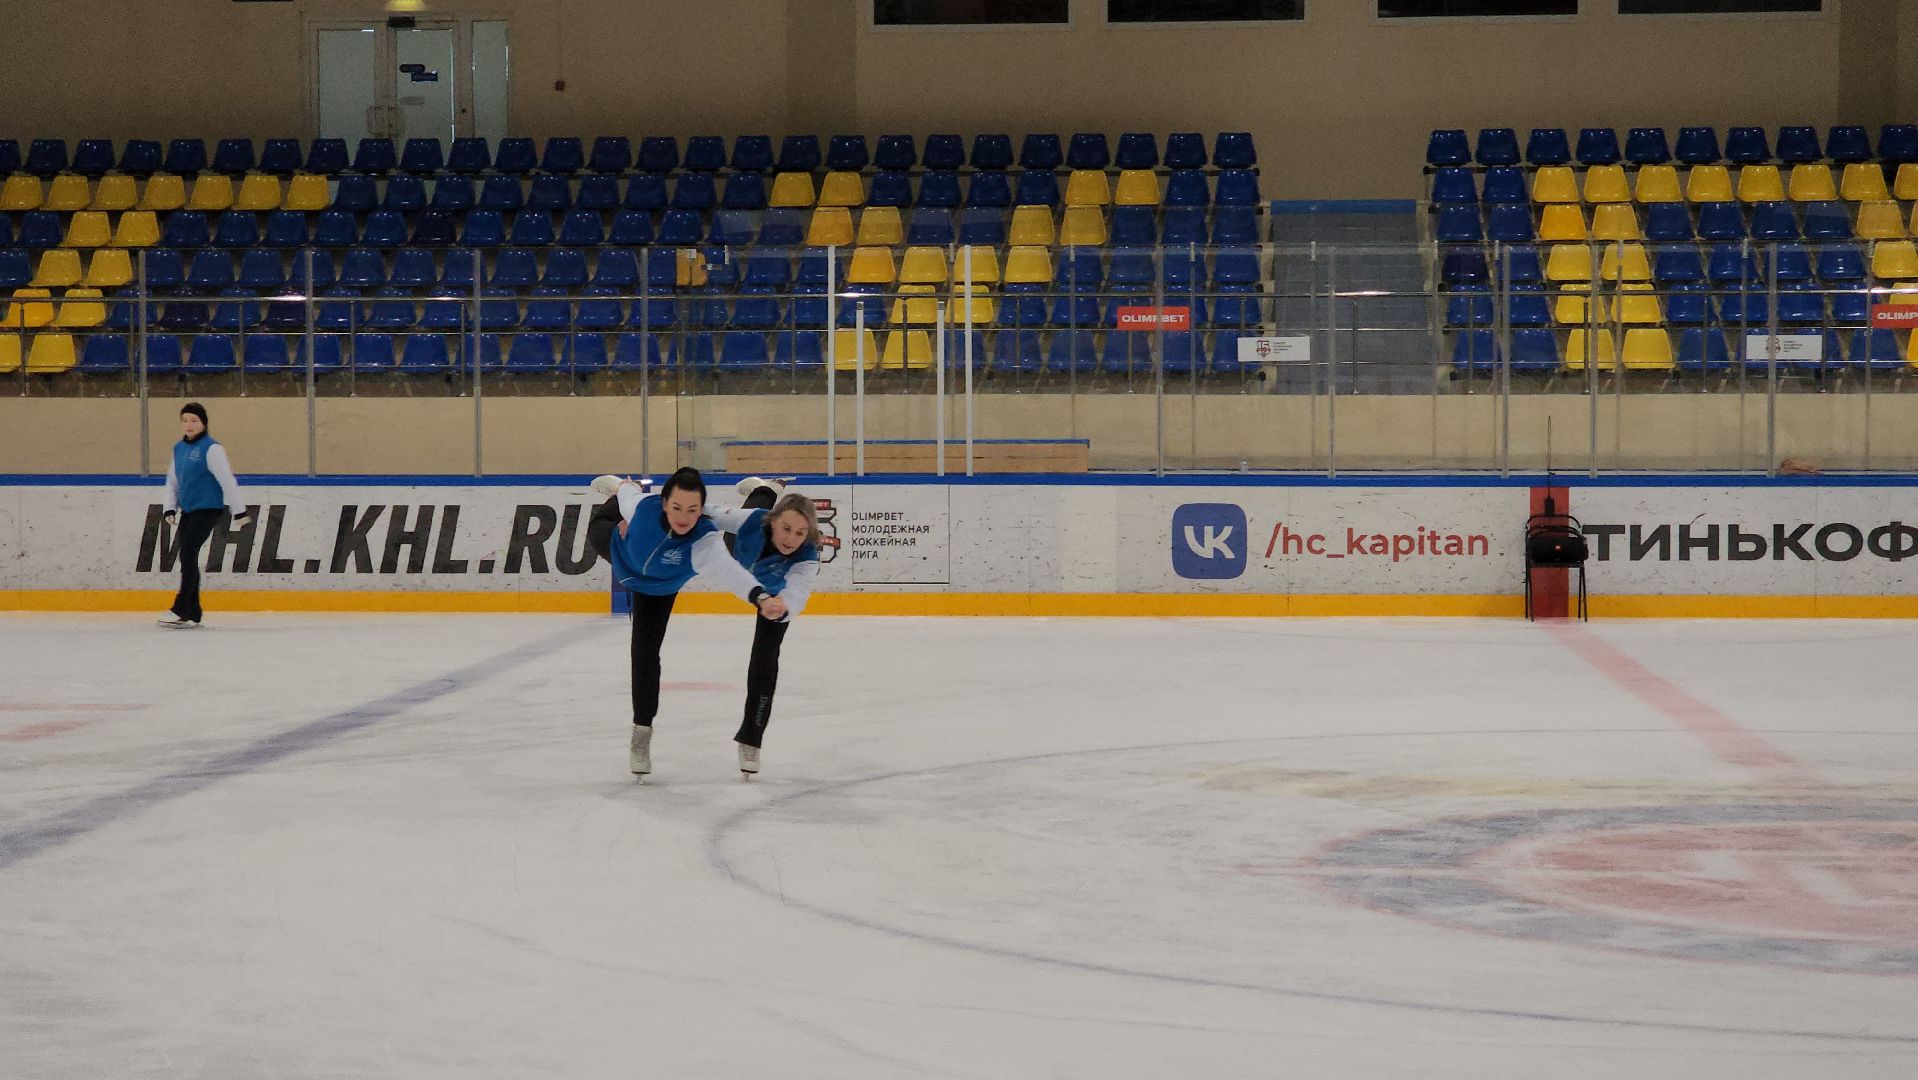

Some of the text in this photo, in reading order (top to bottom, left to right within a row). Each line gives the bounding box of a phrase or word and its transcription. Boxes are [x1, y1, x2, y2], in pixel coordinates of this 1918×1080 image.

[851, 512, 904, 521] OLIMPBET
[851, 525, 930, 535] МОЛОДЕЖНАЯ
[135, 503, 605, 576] MHL.KHL.RU
[851, 535, 916, 546] ХОККЕЙНАЯ
[1265, 521, 1490, 563] /hc_kapitan
[1581, 521, 1918, 563] ТИНЬКОФ
[851, 550, 879, 559] ЛИГА
